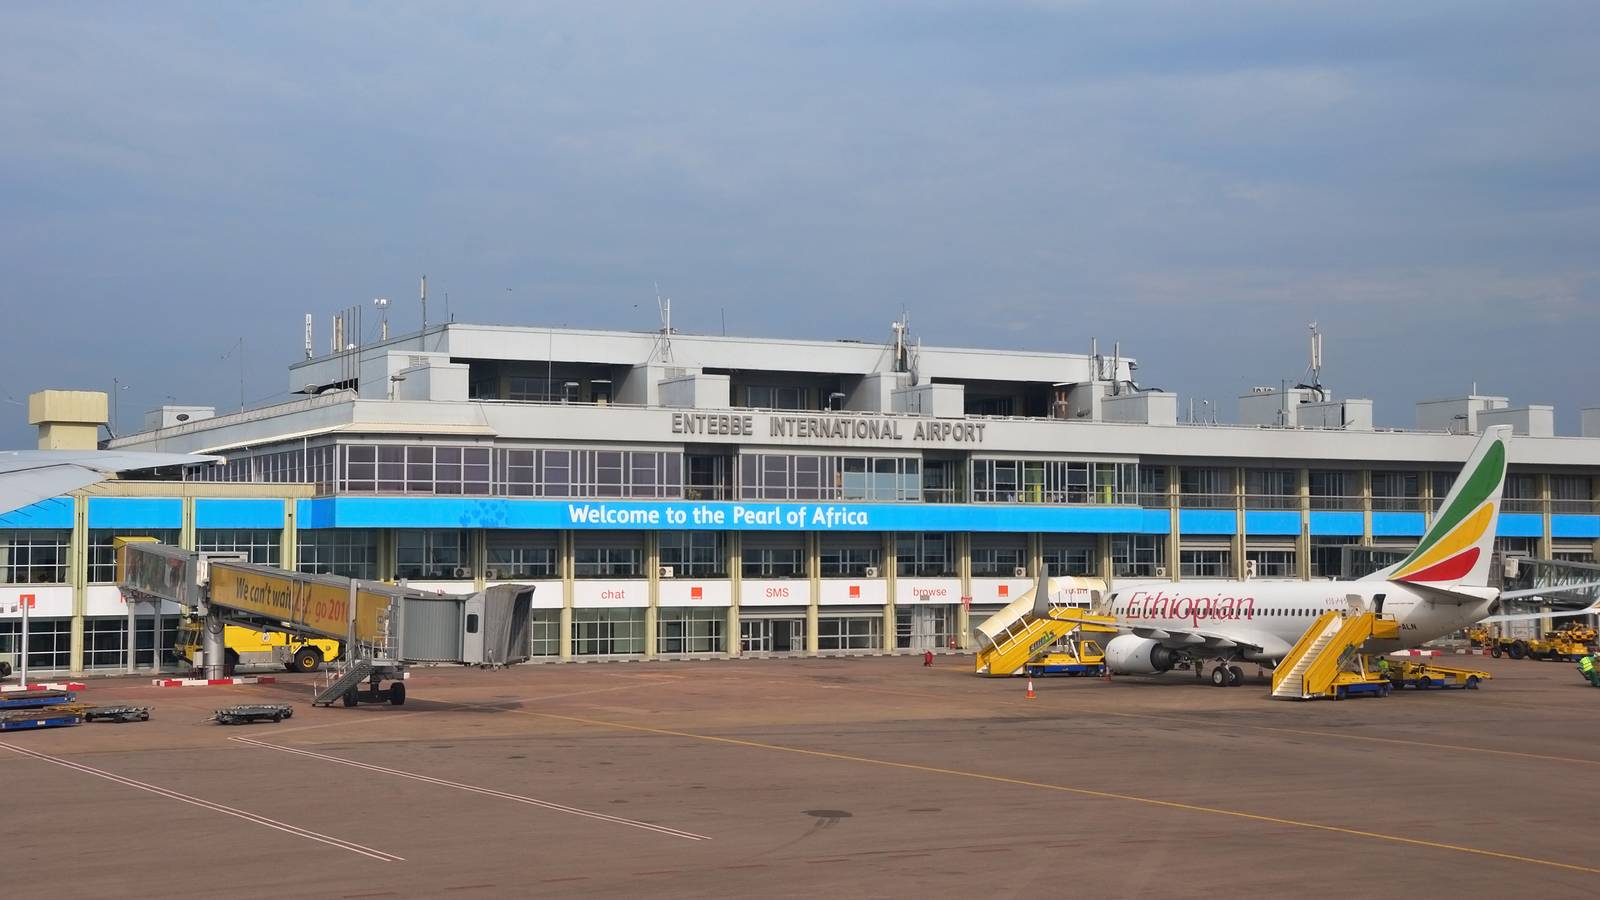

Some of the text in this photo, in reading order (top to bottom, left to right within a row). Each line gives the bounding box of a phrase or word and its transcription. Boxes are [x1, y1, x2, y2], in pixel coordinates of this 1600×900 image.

[671, 412, 986, 443] ENTEBBE INTERNATIONAL AIRPORT
[568, 504, 868, 529] Welcome to the Pearl of Africa
[236, 576, 249, 600] We
[249, 581, 272, 606] can't
[315, 601, 327, 623] go
[601, 589, 625, 600] chat
[766, 587, 789, 598] SMS
[912, 586, 947, 597] browse
[1126, 591, 1255, 628] Ethiopian
